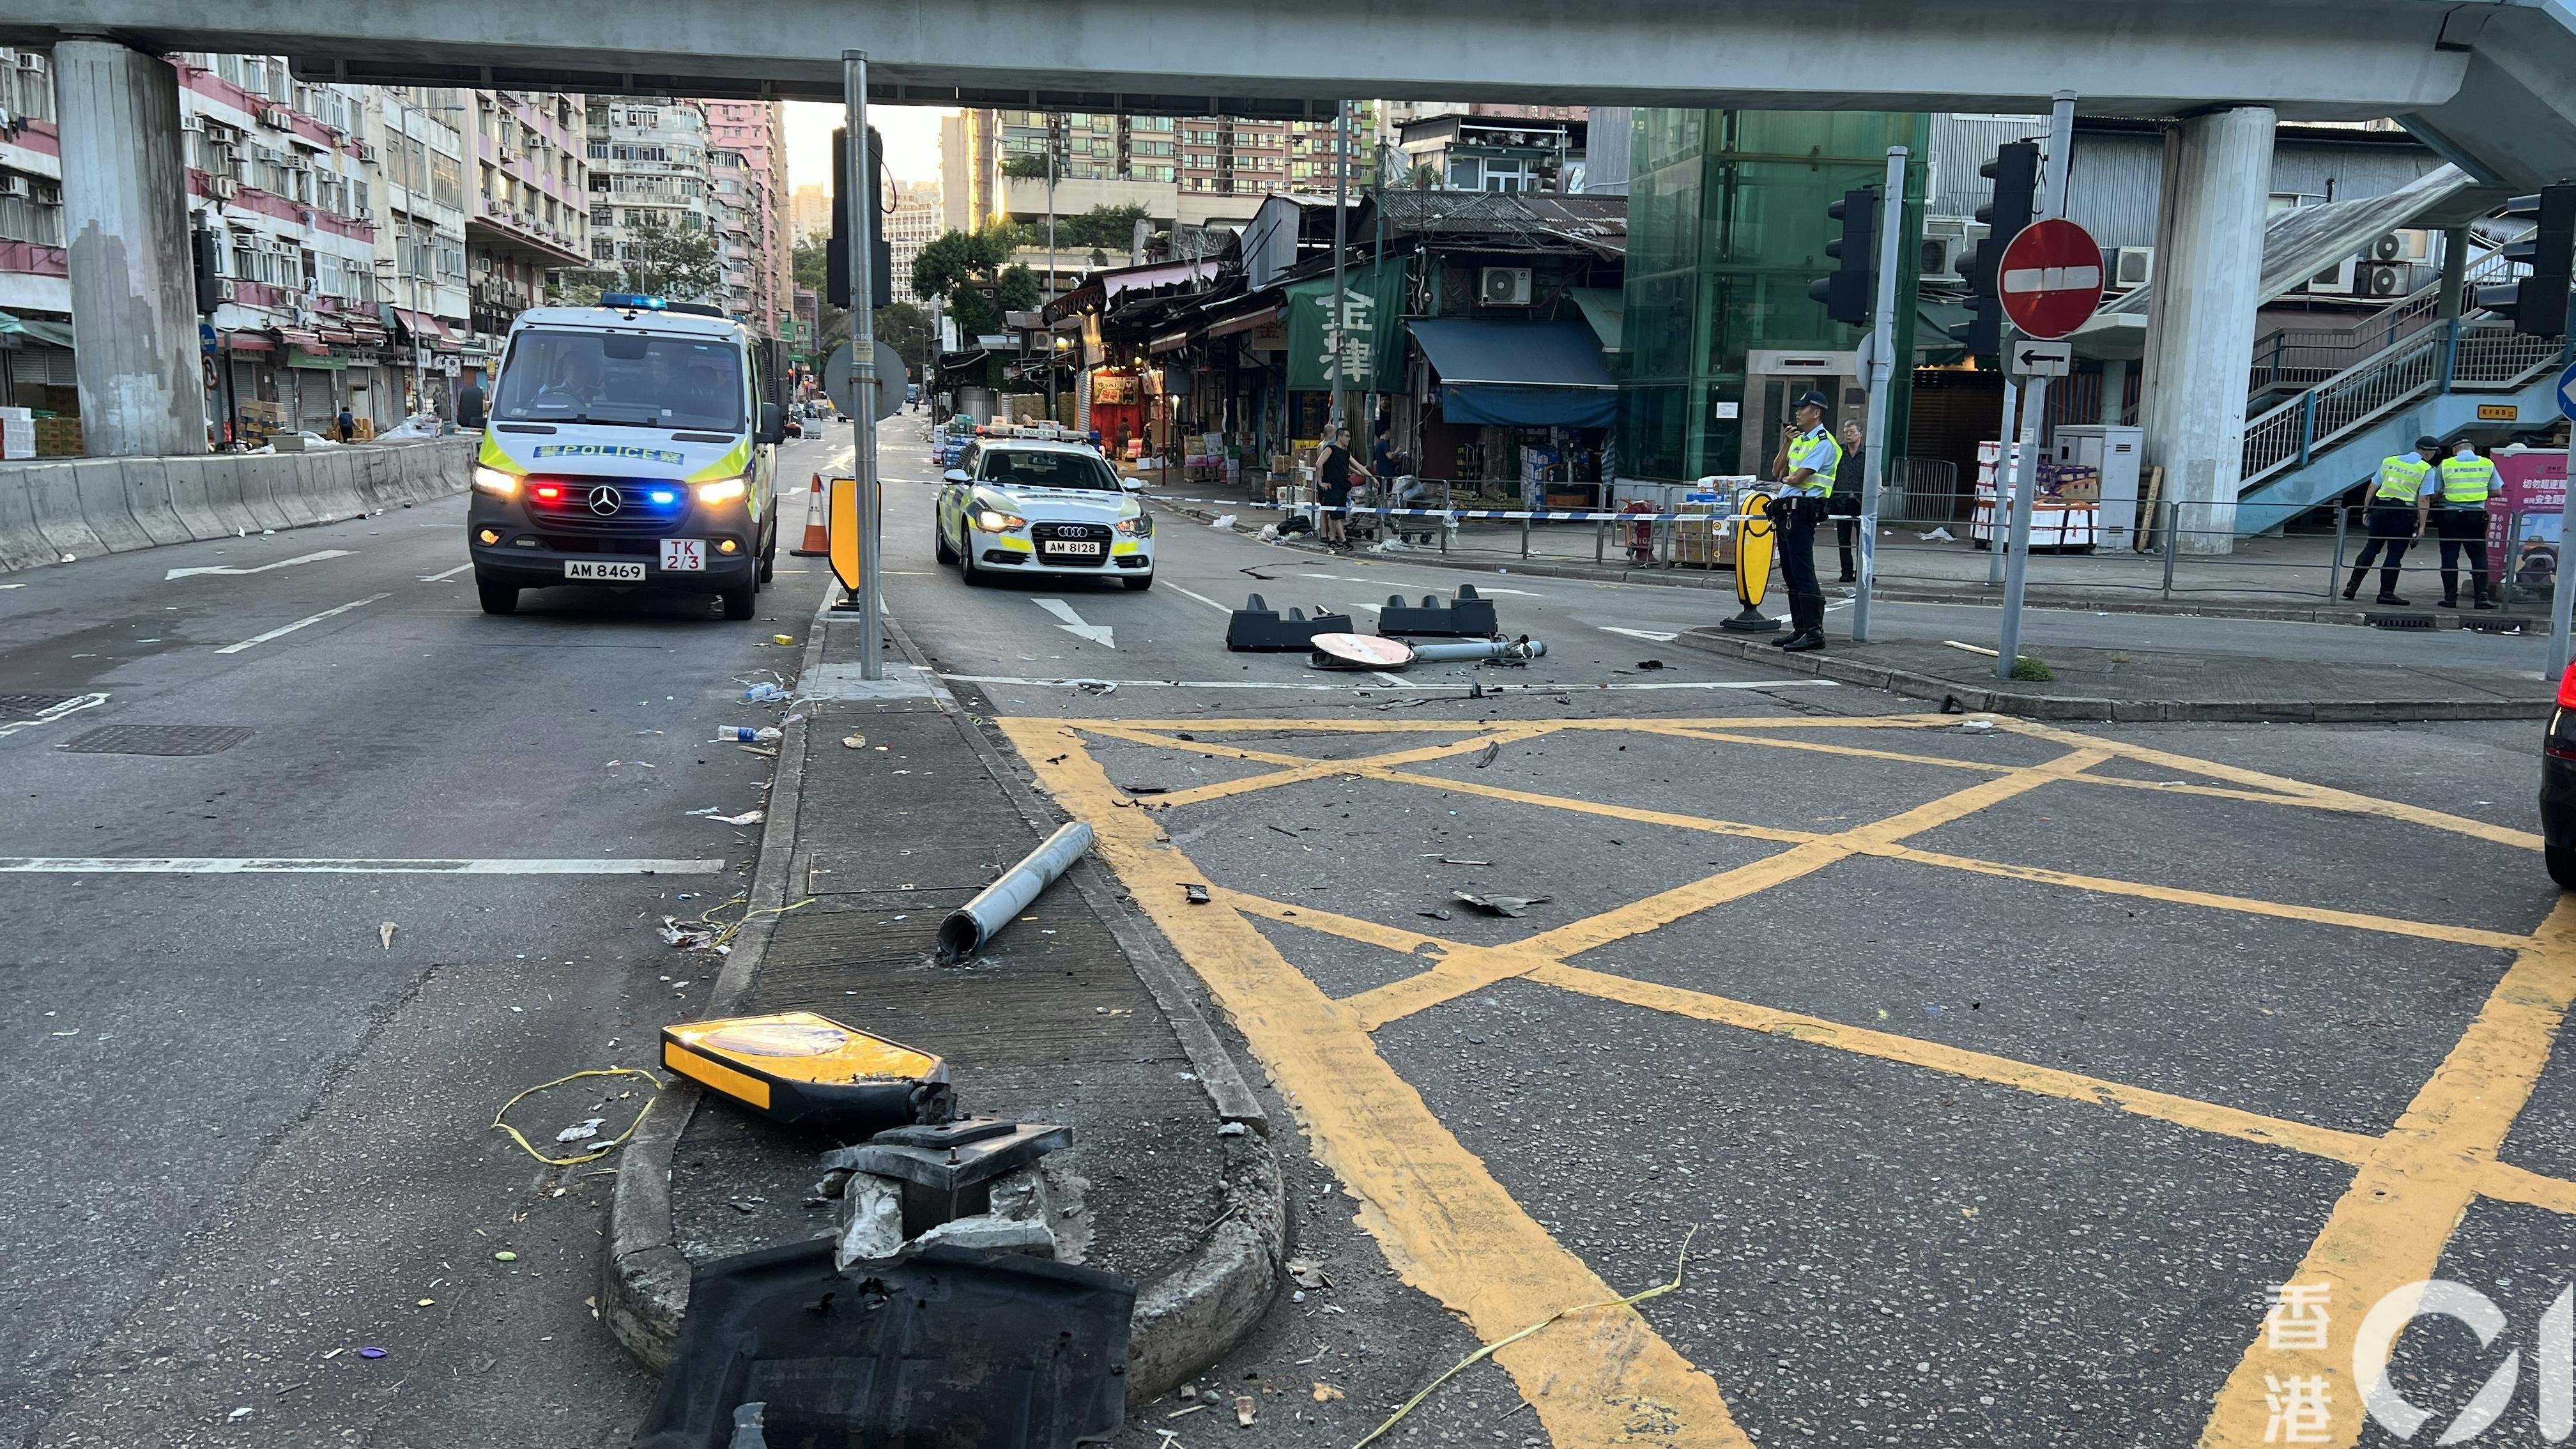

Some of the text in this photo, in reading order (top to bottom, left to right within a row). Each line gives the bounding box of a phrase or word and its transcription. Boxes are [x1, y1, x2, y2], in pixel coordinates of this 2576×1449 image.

[1315, 288, 1380, 383] 金津
[562, 445, 656, 460] POLICE
[671, 542, 694, 555] TK
[1050, 543, 1096, 553] AM 8128
[668, 556, 699, 569] 2/3
[570, 564, 641, 579] AM 8469
